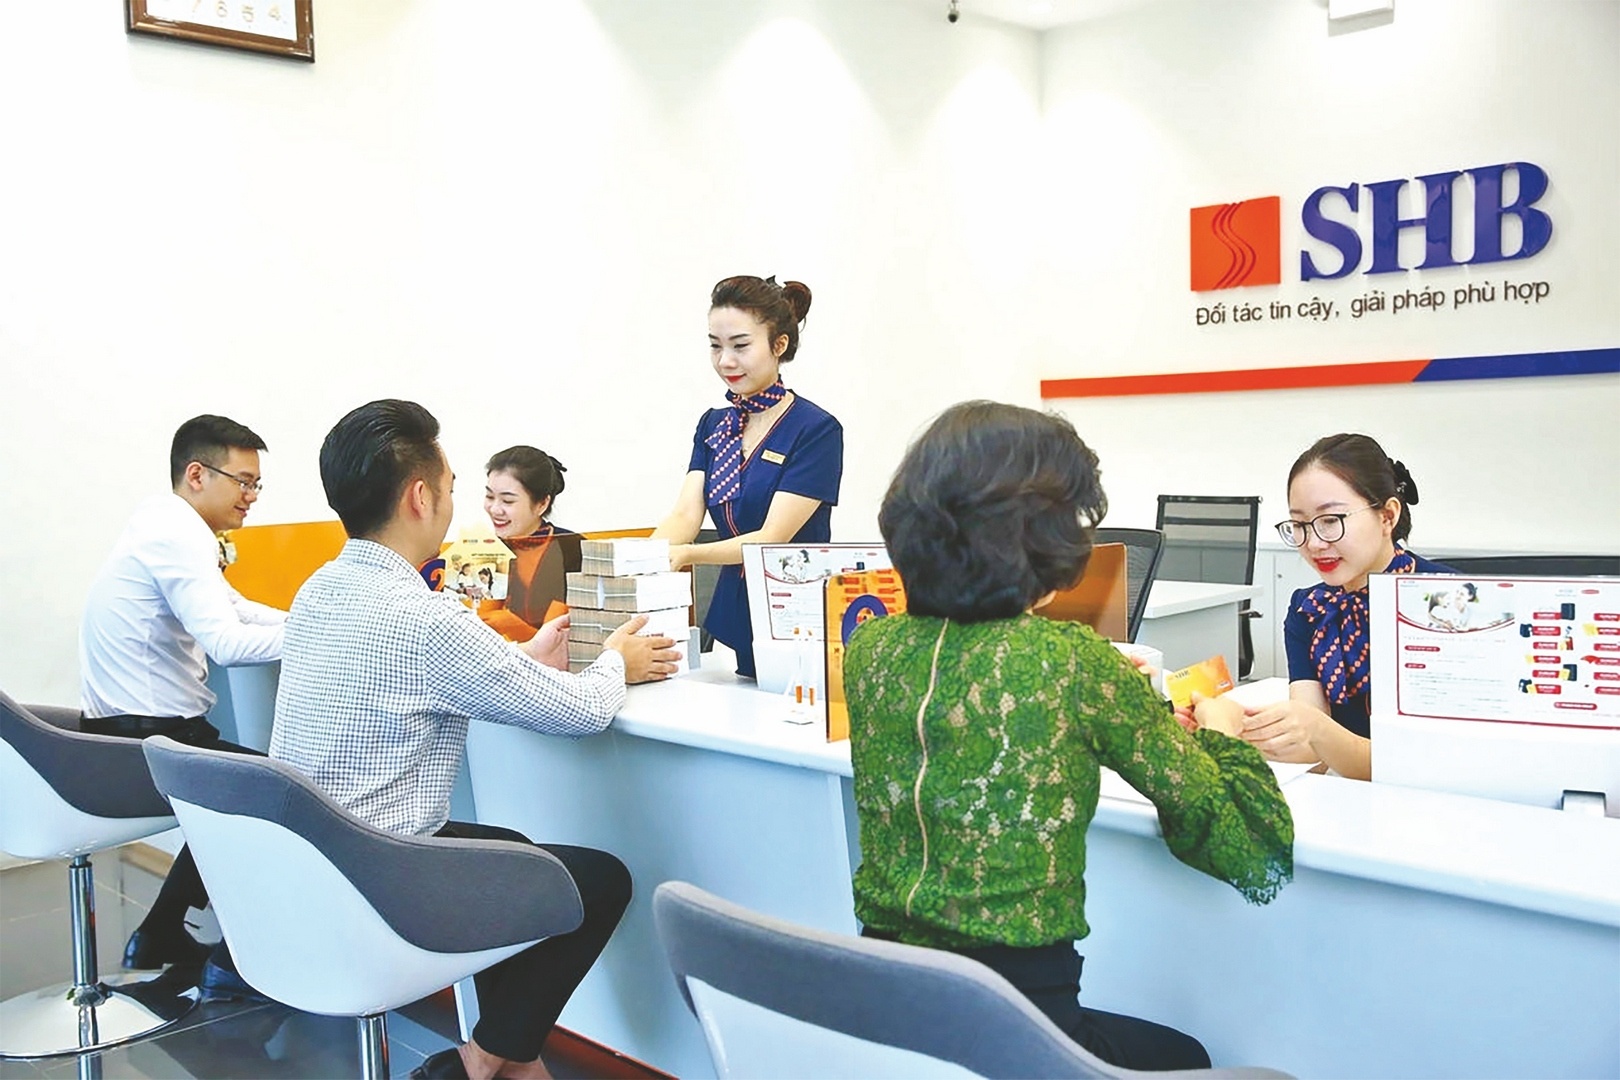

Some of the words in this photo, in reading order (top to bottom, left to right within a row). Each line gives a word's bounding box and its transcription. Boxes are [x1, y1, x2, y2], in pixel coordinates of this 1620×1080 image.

[216, 0, 228, 18] 6
[242, 4, 254, 23] 5
[1300, 162, 1553, 282] SHB
[1196, 302, 1226, 326] Đối
[1232, 302, 1263, 323] tác
[1269, 301, 1292, 320] tin
[1297, 296, 1340, 322] cậy,
[1350, 289, 1386, 318] giải
[1392, 285, 1445, 315] pháp
[1454, 280, 1496, 310] phù
[1503, 280, 1551, 304] hợp
